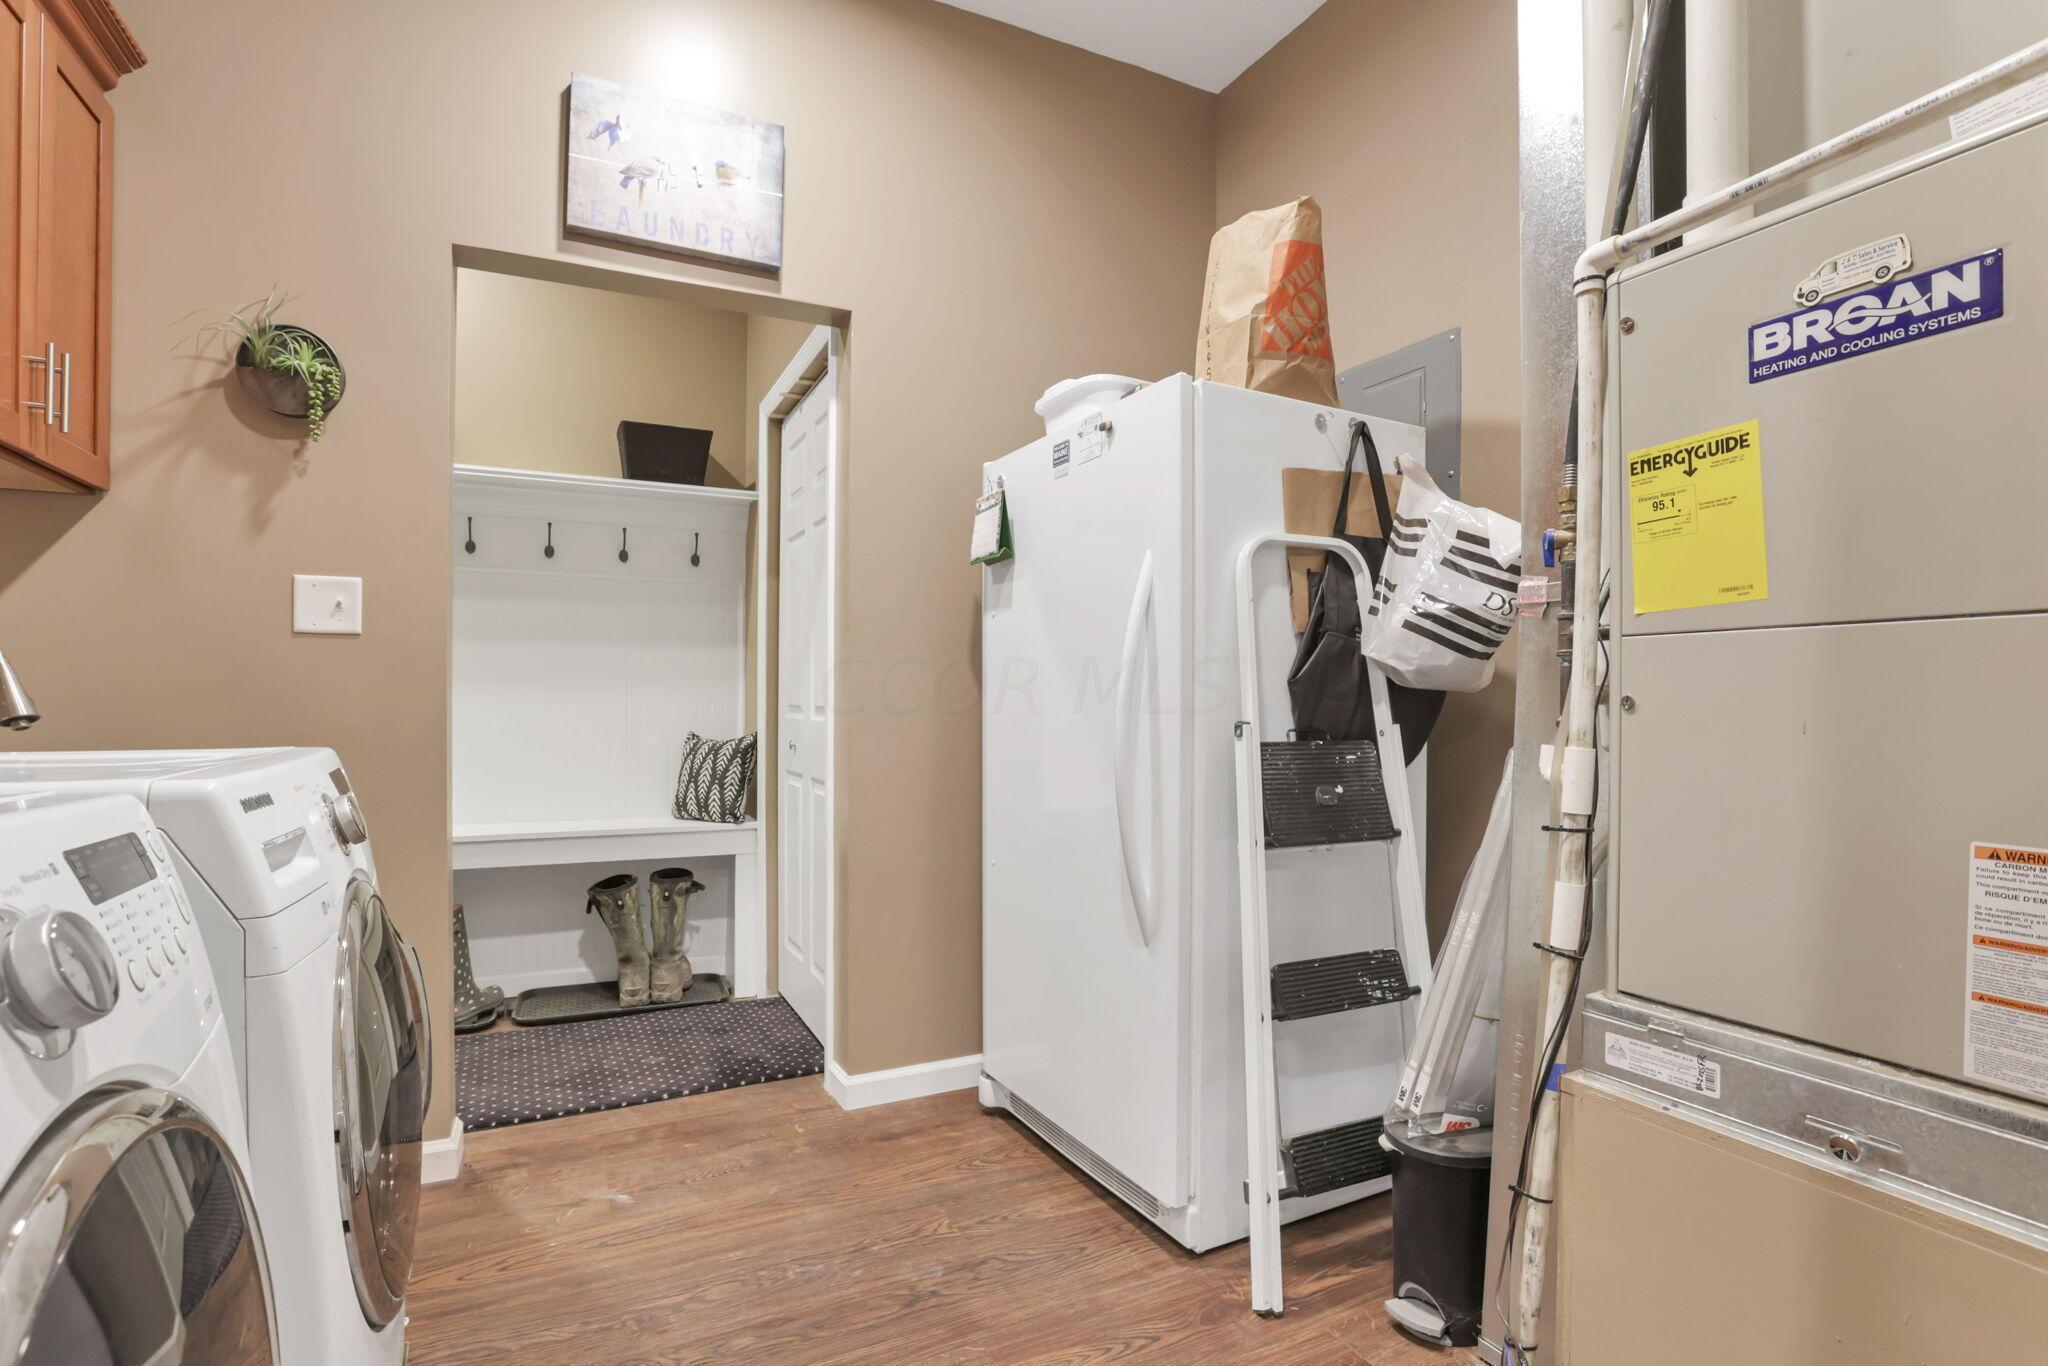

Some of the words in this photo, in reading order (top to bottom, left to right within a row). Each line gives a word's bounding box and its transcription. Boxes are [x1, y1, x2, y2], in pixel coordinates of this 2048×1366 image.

[590, 200, 759, 257] LAUNDRY
[1878, 241, 1898, 251] Service
[1753, 260, 1981, 362] BROAN
[1753, 354, 1806, 377] HEATING
[1809, 347, 1837, 363] AND
[1840, 328, 1905, 354] COOLING
[1908, 307, 1982, 335] SYSTEMS
[1630, 432, 1751, 477] ENERGYGUIDE
[1652, 498, 1675, 511] 95.1
[1482, 591, 1519, 616] DS
[1976, 866, 2000, 874] Failure
[1995, 861, 2036, 873] CARBON
[1985, 890, 2020, 901] RISQUE
[1992, 884, 2040, 895] compartment
[1995, 908, 2046, 919] compartiment
[1985, 926, 2034, 939] compartiment
